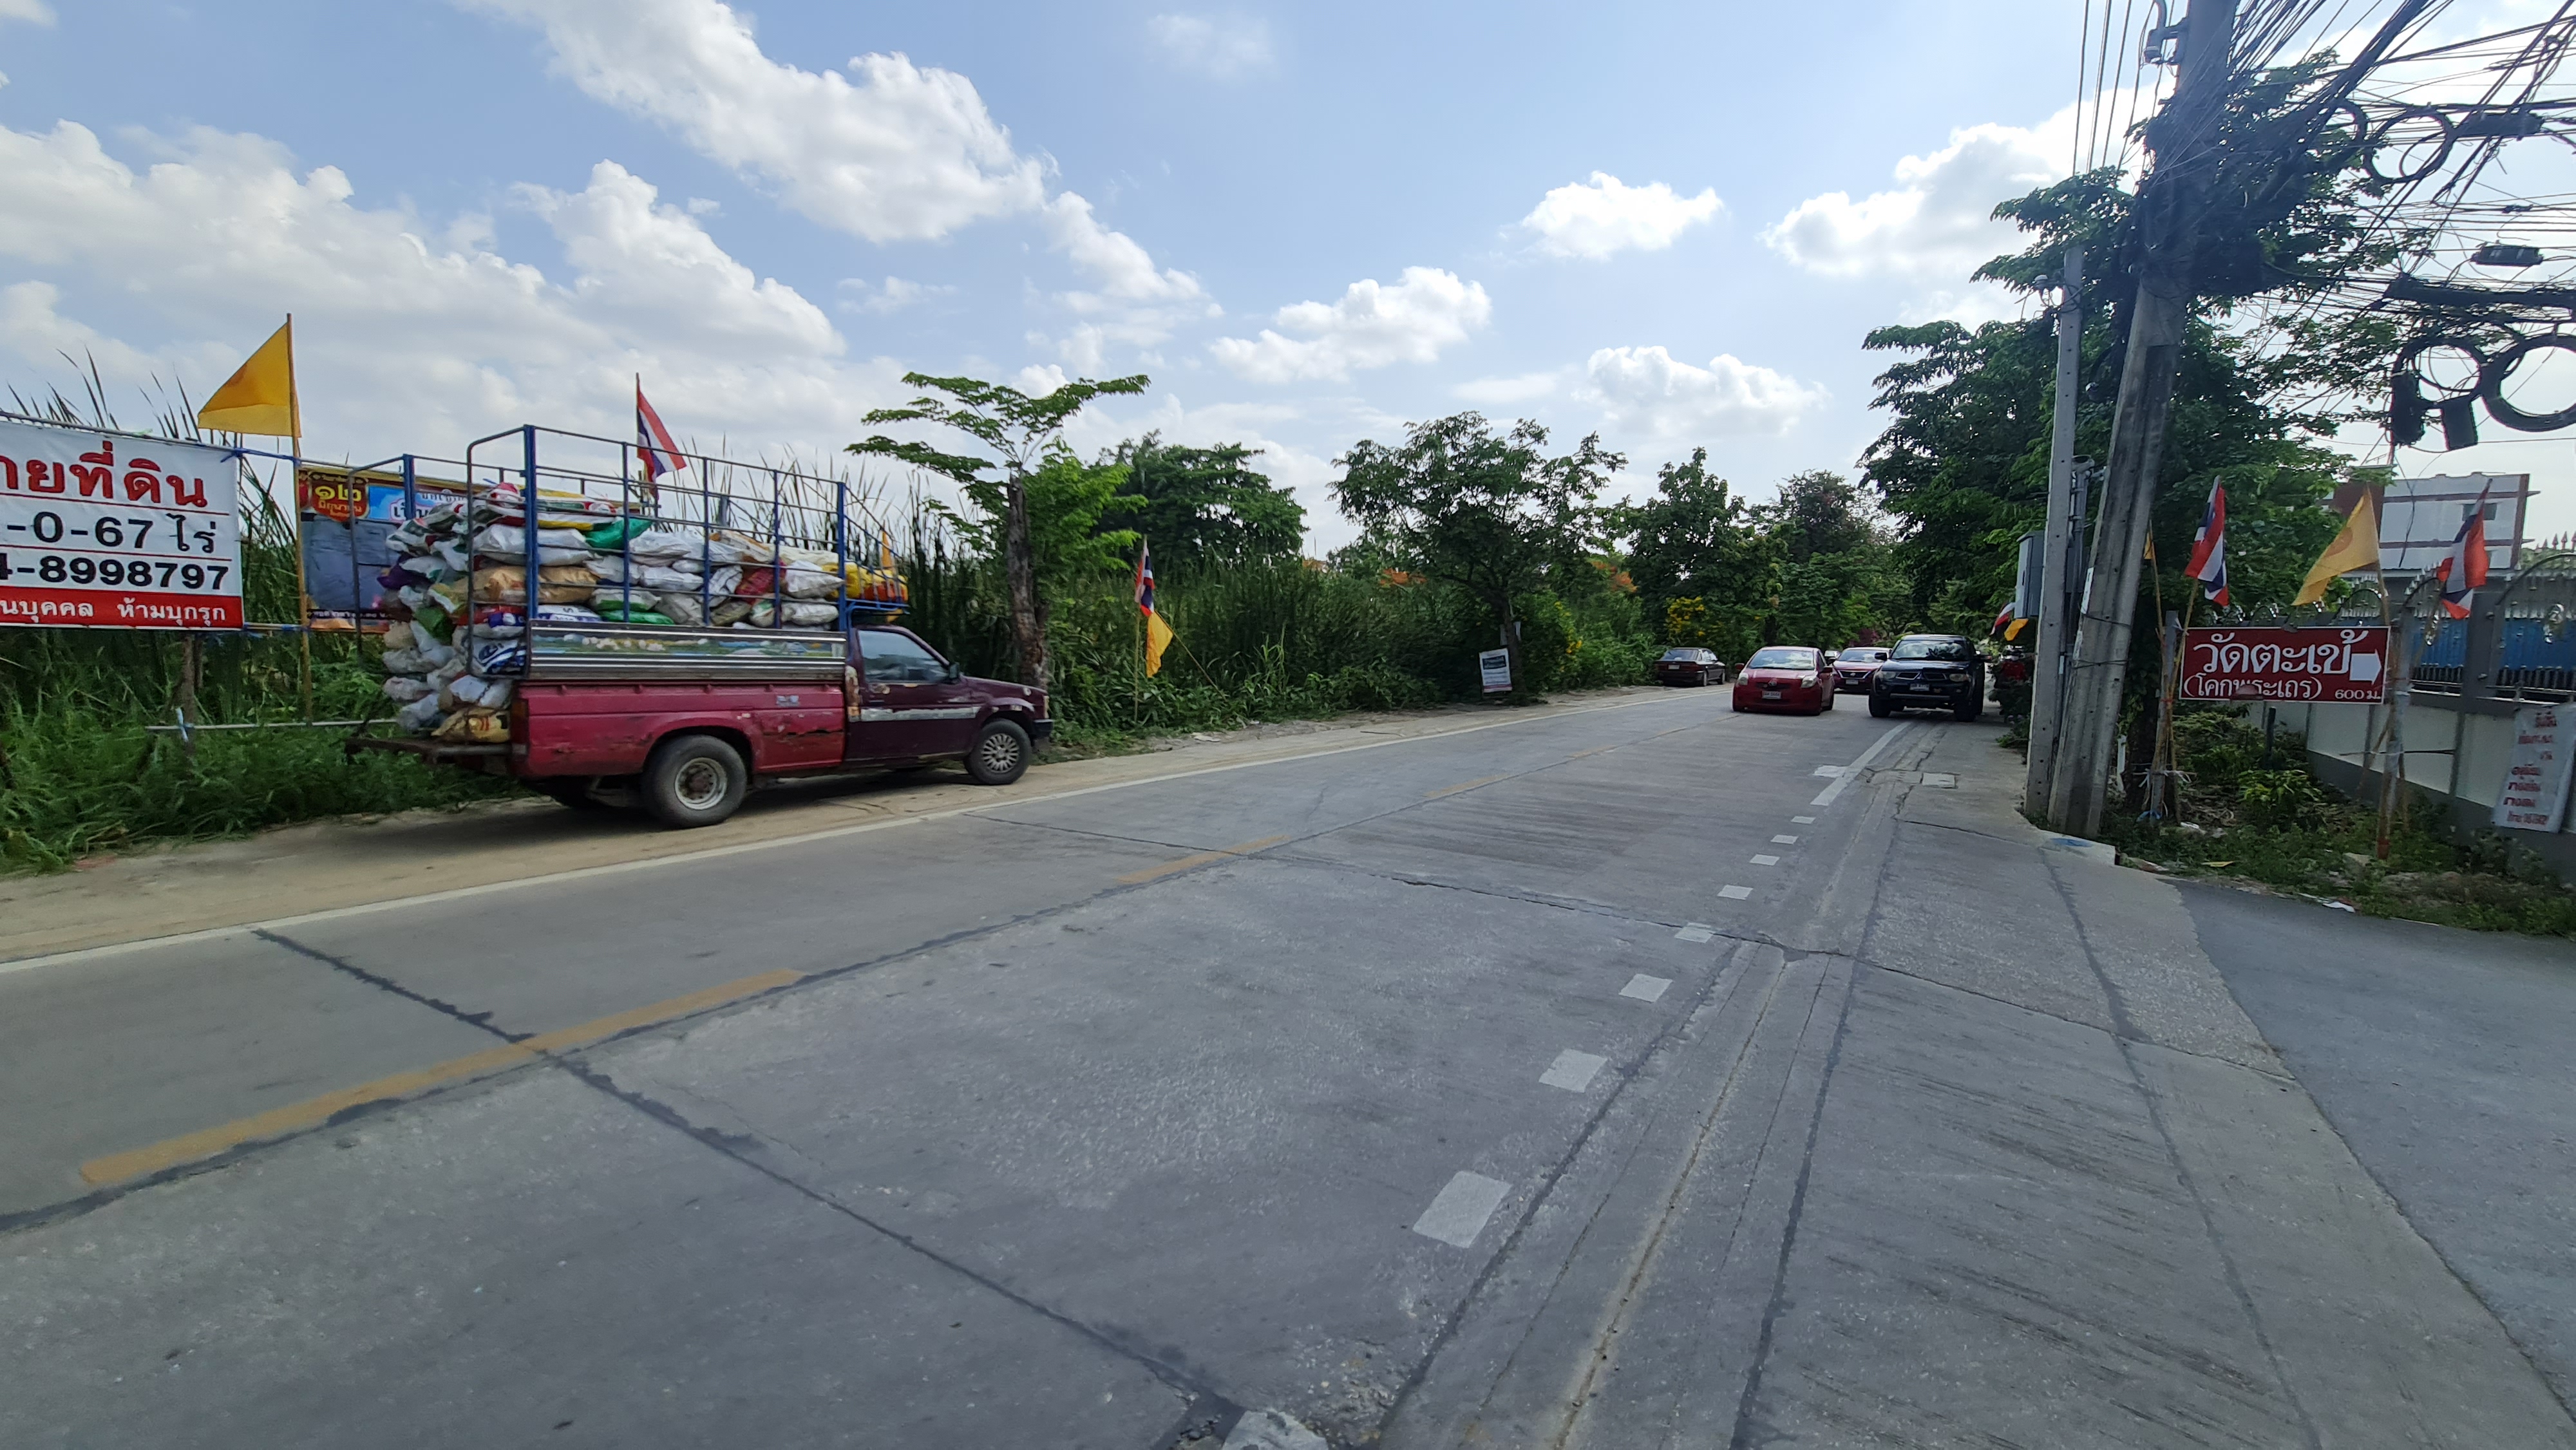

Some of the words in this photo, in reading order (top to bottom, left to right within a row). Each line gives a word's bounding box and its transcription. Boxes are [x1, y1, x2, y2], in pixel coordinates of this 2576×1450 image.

[166, 513, 216, 552] ไร่
[117, 597, 225, 626] ห้ามบุกรุก
[2193, 628, 2369, 674] วัดตะเข้
